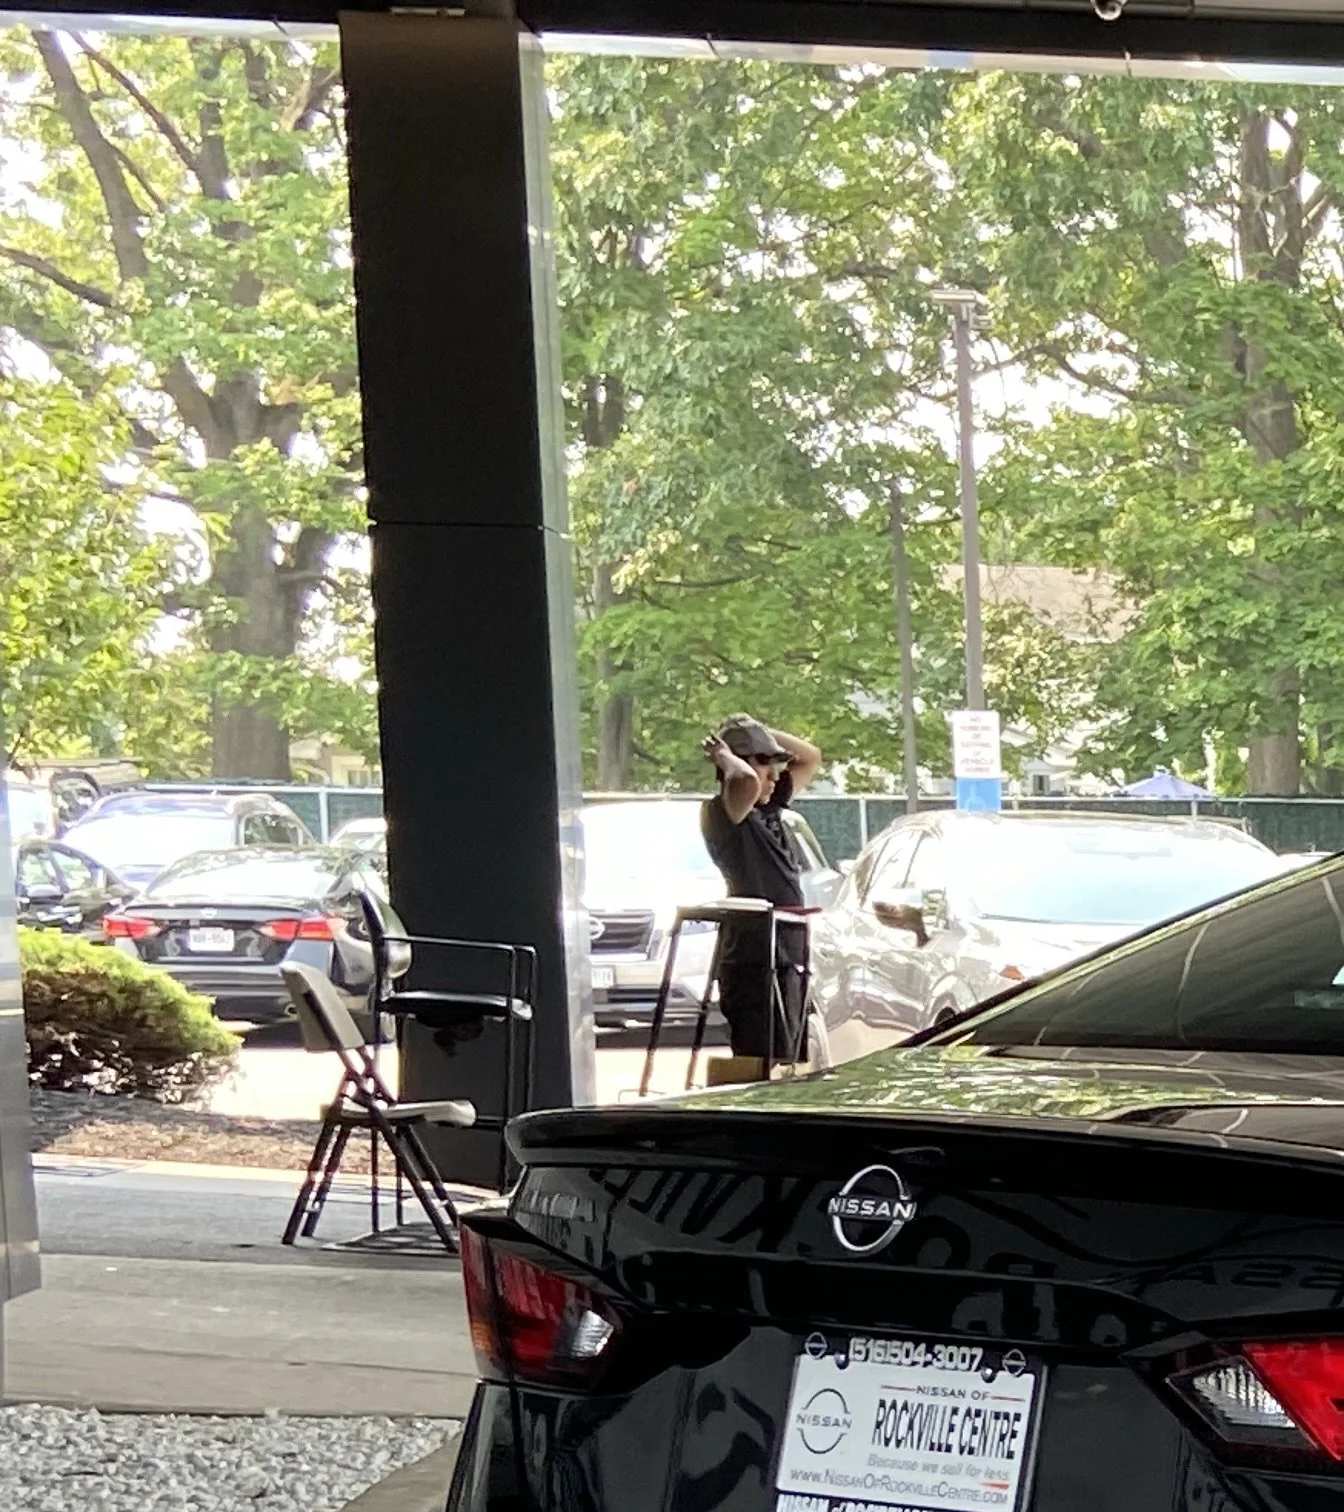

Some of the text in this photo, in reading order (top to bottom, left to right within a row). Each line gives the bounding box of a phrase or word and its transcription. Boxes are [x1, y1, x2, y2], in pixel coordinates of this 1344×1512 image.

[828, 1197, 916, 1219] NISSAN
[915, 1385, 991, 1400] NISSAN OF
[796, 1413, 852, 1429] NISSAN
[872, 1398, 1022, 1460] ROCKVILLE CENTRE
[867, 1453, 918, 1472] Because
[921, 1461, 939, 1473] we
[965, 1463, 982, 1478] for
[985, 1465, 1009, 1480] less
